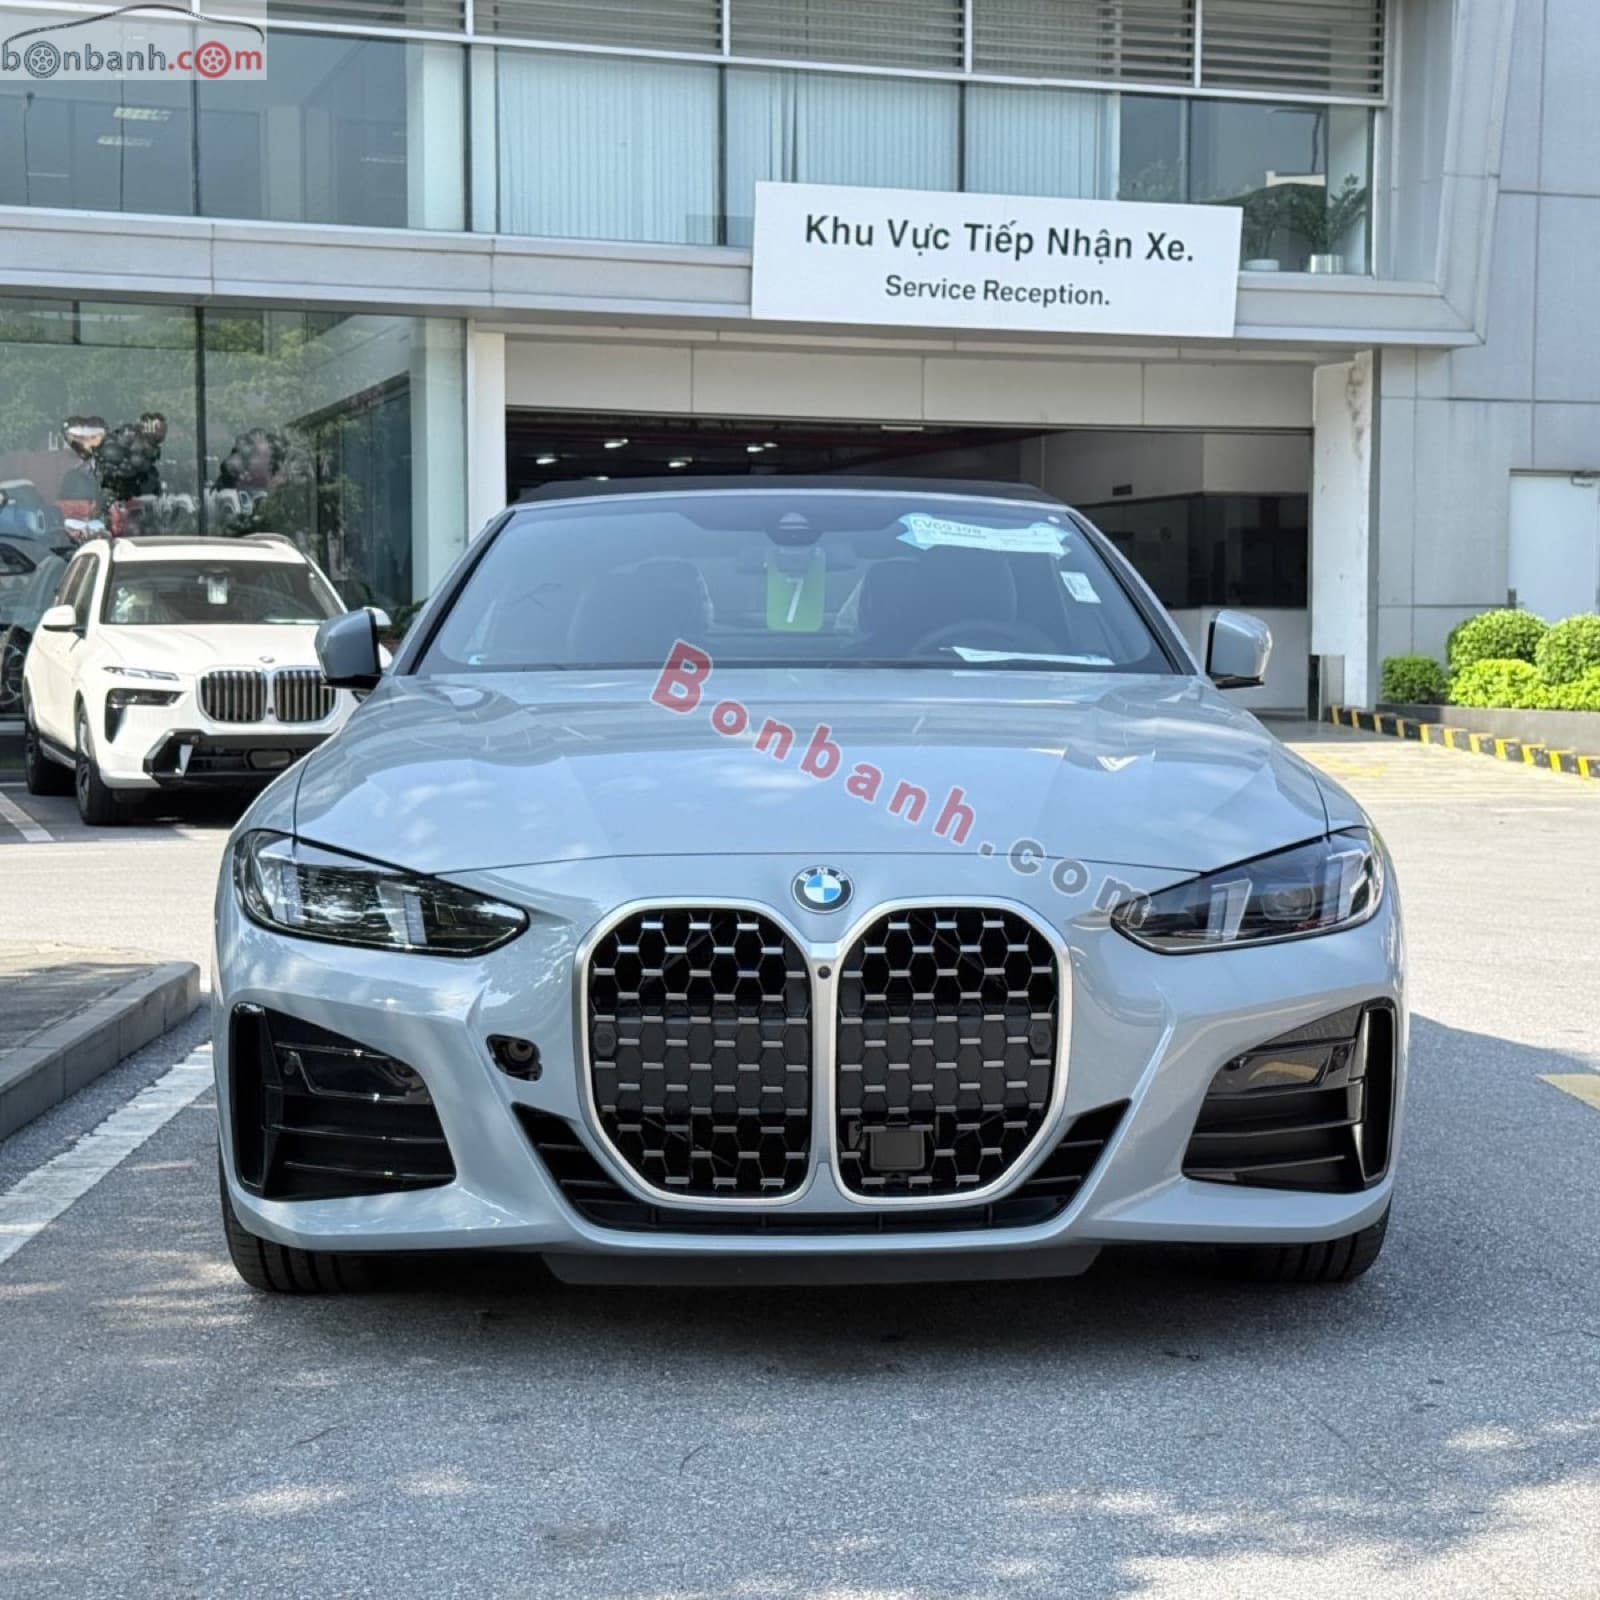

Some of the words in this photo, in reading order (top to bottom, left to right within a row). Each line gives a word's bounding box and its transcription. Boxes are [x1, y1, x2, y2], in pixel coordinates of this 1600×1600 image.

[805, 214, 874, 247] Khu
[887, 219, 951, 256] Vực
[963, 219, 1034, 261] Tiếp
[1048, 227, 1133, 264] Nhận
[1145, 232, 1195, 262] Xe.
[885, 274, 976, 300] Service
[983, 280, 1111, 308] Reception.
